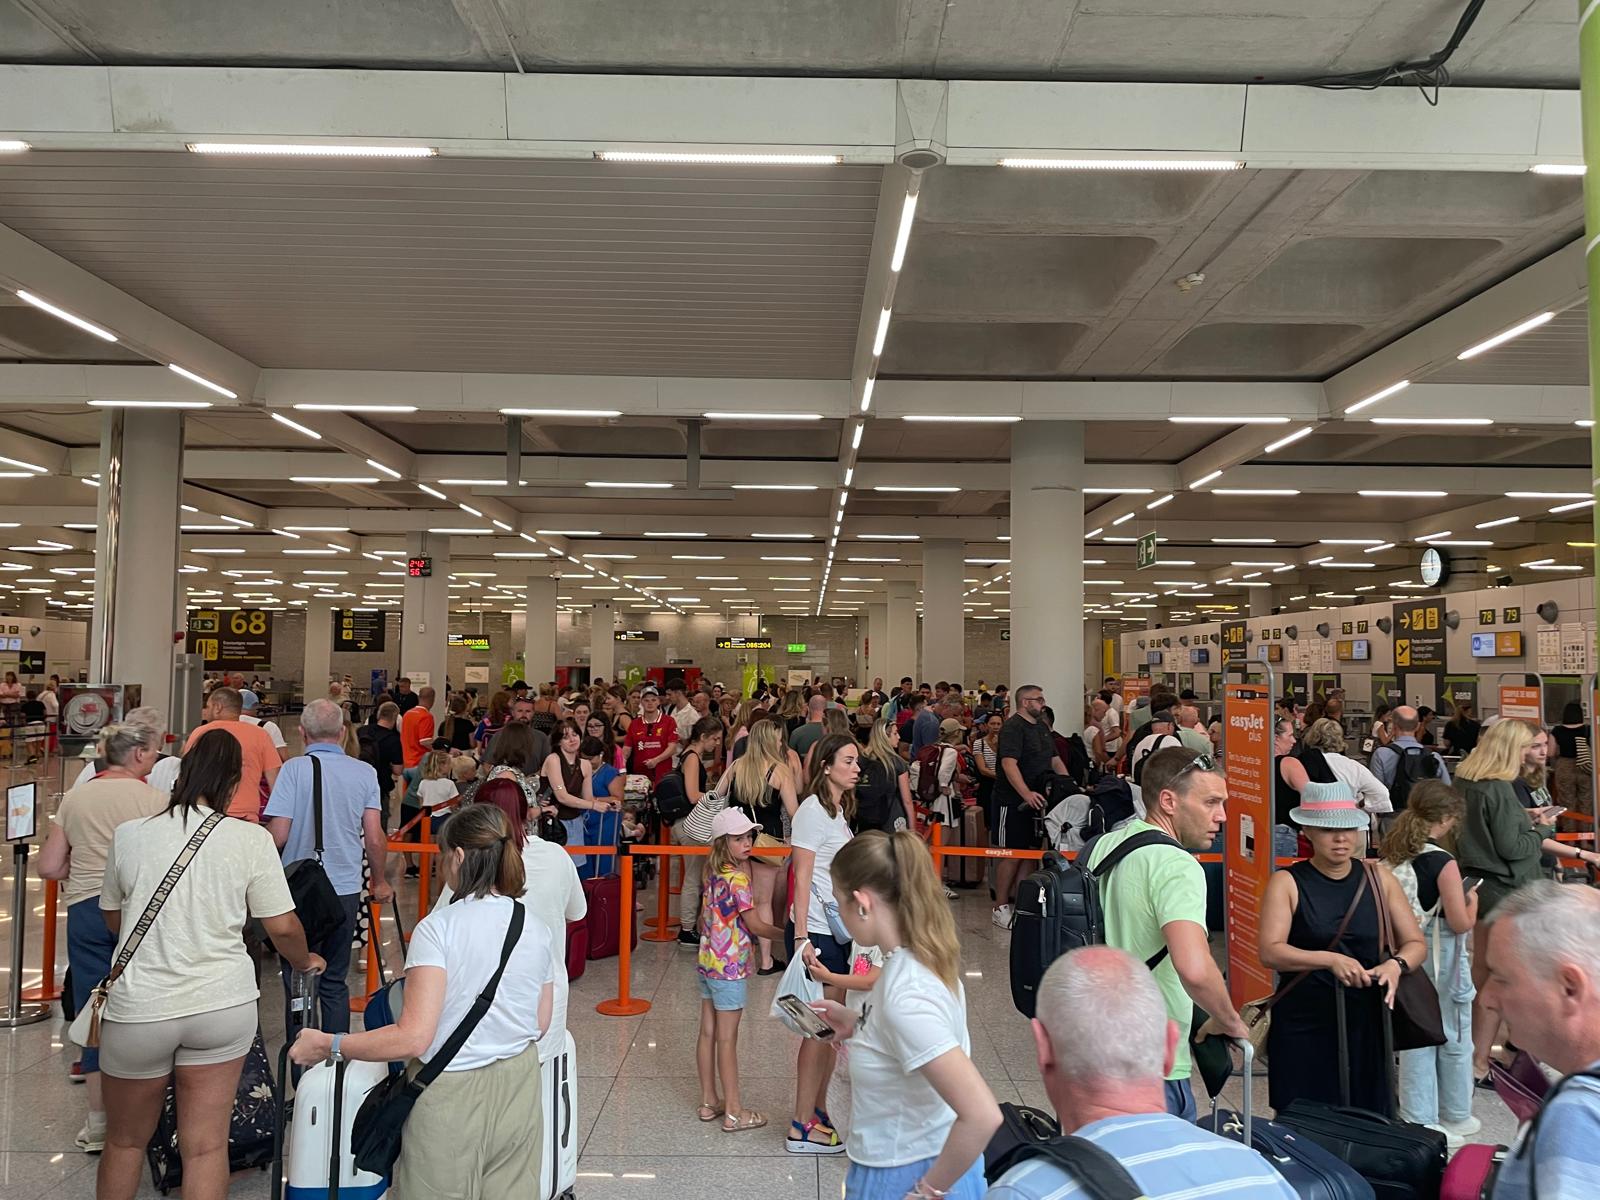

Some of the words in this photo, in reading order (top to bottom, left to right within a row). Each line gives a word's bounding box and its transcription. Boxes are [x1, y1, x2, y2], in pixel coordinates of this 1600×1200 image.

[1481, 611, 1493, 623] 78
[1505, 609, 1518, 621] 79
[230, 611, 266, 635] 68
[1343, 623, 1351, 633] 76
[1358, 622, 1367, 632] 77
[1455, 691, 1472, 700] aena
[1230, 713, 1264, 731] easyJet
[1248, 730, 1262, 742] plus
[187, 819, 217, 851] ISLAND
[157, 863, 184, 896] RIVER
[134, 898, 164, 936] ISLAND
